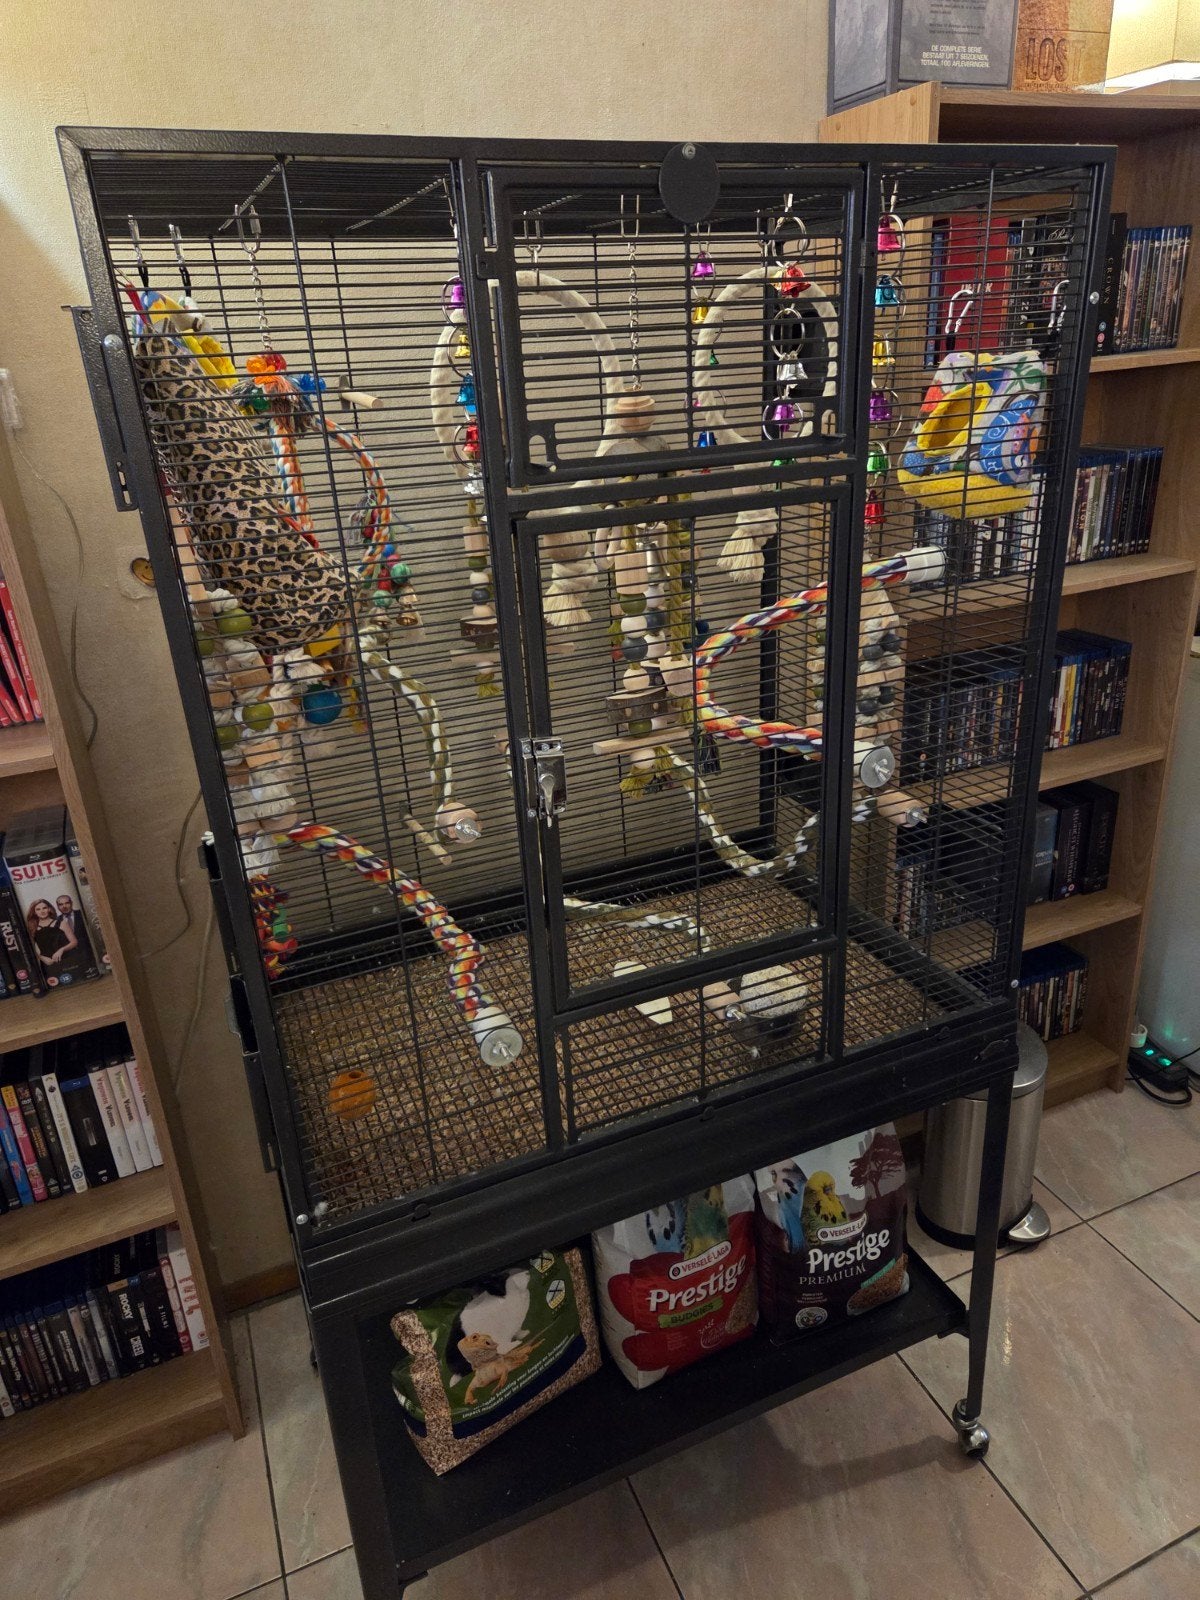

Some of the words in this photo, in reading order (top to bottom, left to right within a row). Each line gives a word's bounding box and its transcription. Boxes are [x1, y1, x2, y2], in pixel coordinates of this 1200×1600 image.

[1026, 37, 1087, 82] LOST
[1019, 245, 1035, 326] PENZA
[1103, 257, 1114, 304] CROWN
[11, 858, 67, 882] SUITS
[1, 921, 19, 951] RUST
[681, 1245, 729, 1273] VERSELE-LAGA
[806, 1229, 890, 1274] Prestige
[645, 1254, 747, 1312] Prestige
[799, 1262, 867, 1285] PREMIUM
[119, 1293, 134, 1319] ROCKY
[670, 1302, 714, 1324] BUDGIES
[130, 1335, 145, 1356] CREED
